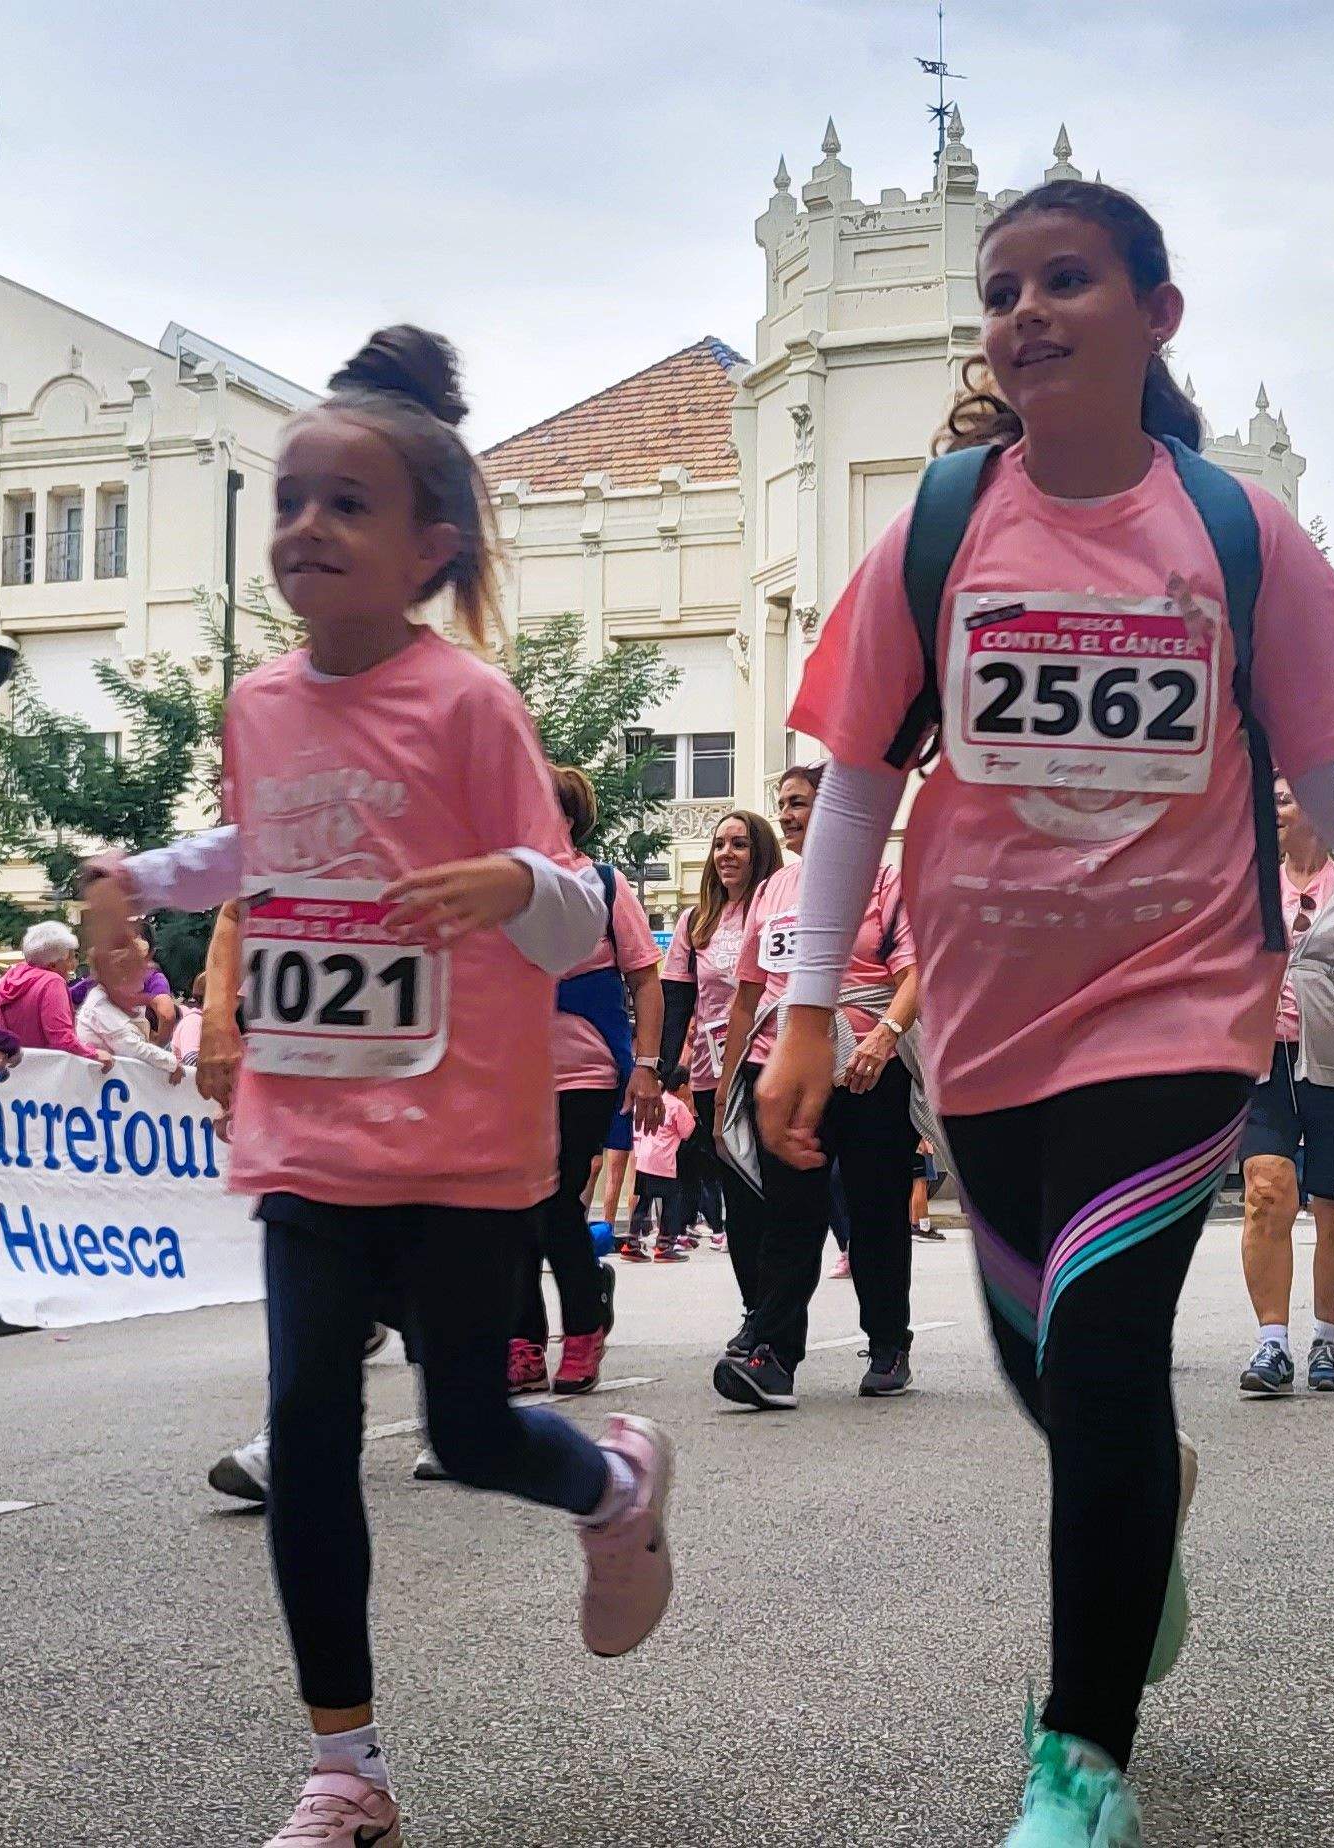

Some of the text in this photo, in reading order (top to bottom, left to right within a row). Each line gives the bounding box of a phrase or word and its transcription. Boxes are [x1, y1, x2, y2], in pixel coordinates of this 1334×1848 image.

[981, 631, 1075, 652] CONTRA
[1080, 634, 1105, 652] EL
[974, 661, 1197, 742] 2562
[249, 949, 420, 1028] 1021
